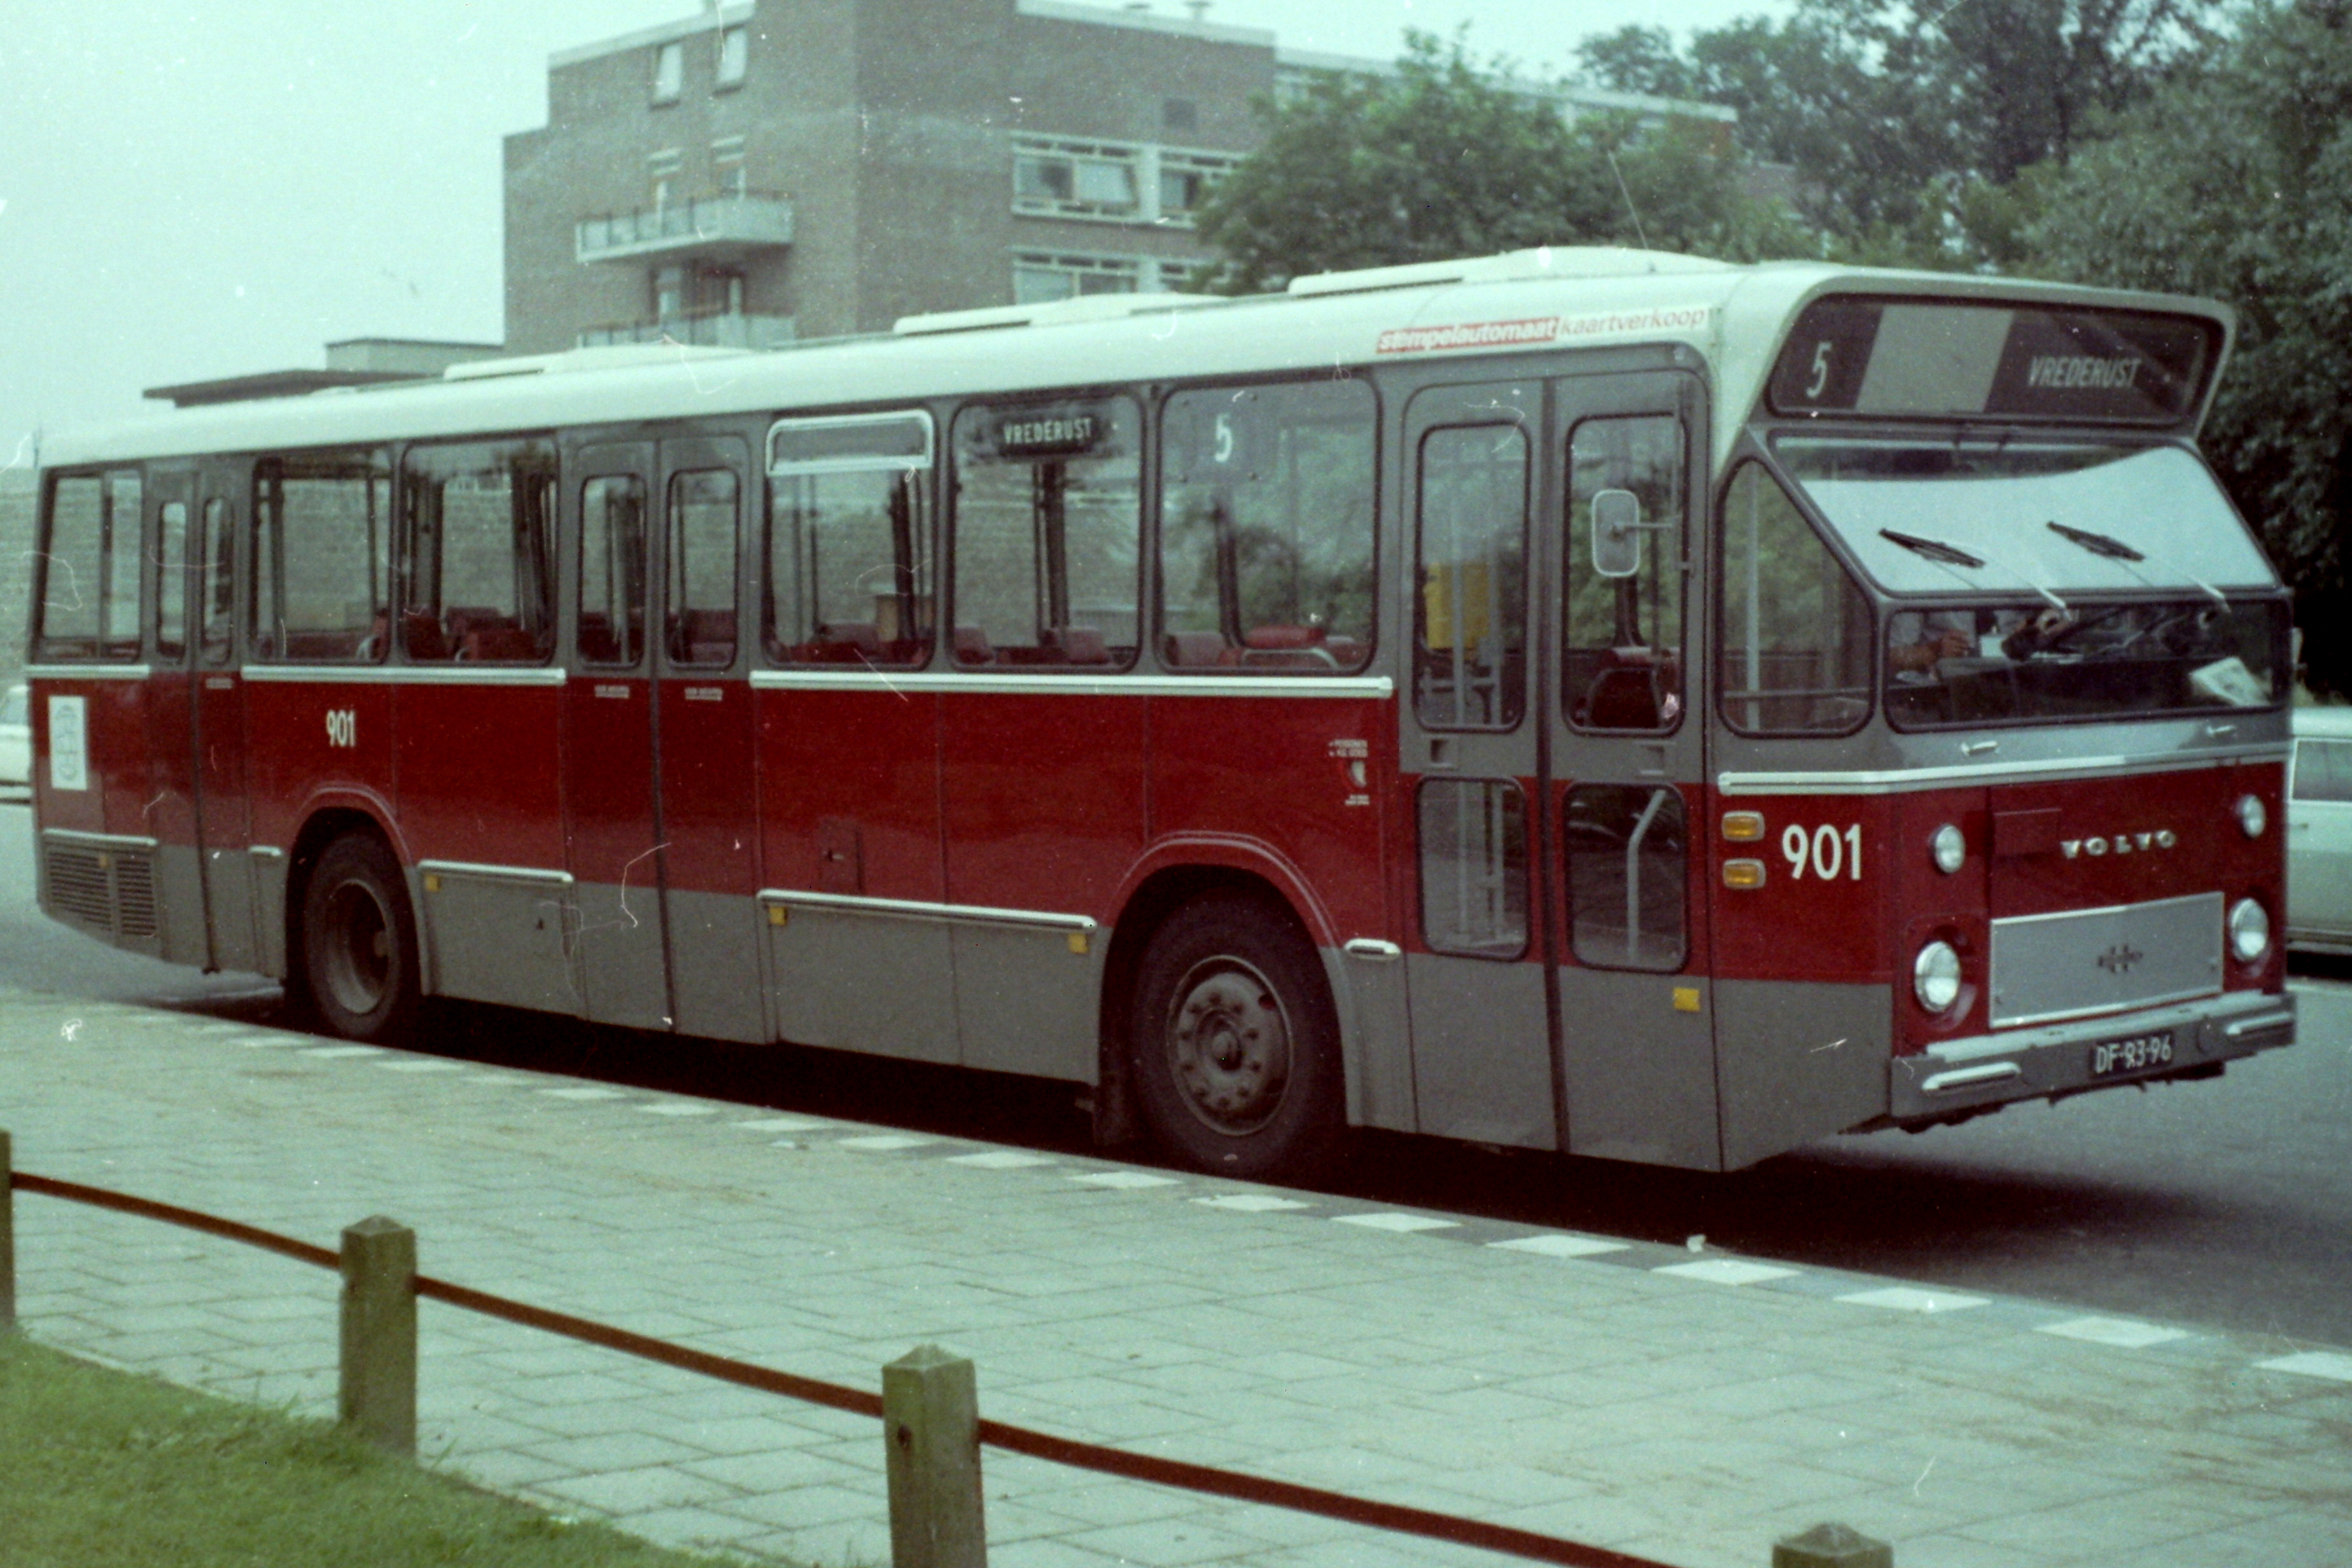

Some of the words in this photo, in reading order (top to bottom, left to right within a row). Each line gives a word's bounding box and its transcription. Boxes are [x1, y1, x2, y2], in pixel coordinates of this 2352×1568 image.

[1559, 309, 1704, 336] kaartverkoop
[1806, 342, 1832, 399] 5
[2028, 355, 2142, 387] VREDERUST
[1004, 417, 1092, 445] VREDERUST
[1215, 414, 1233, 463] 5
[325, 708, 356, 748] 901
[1782, 823, 1861, 881] 901
[2061, 829, 2176, 859] VOLVO
